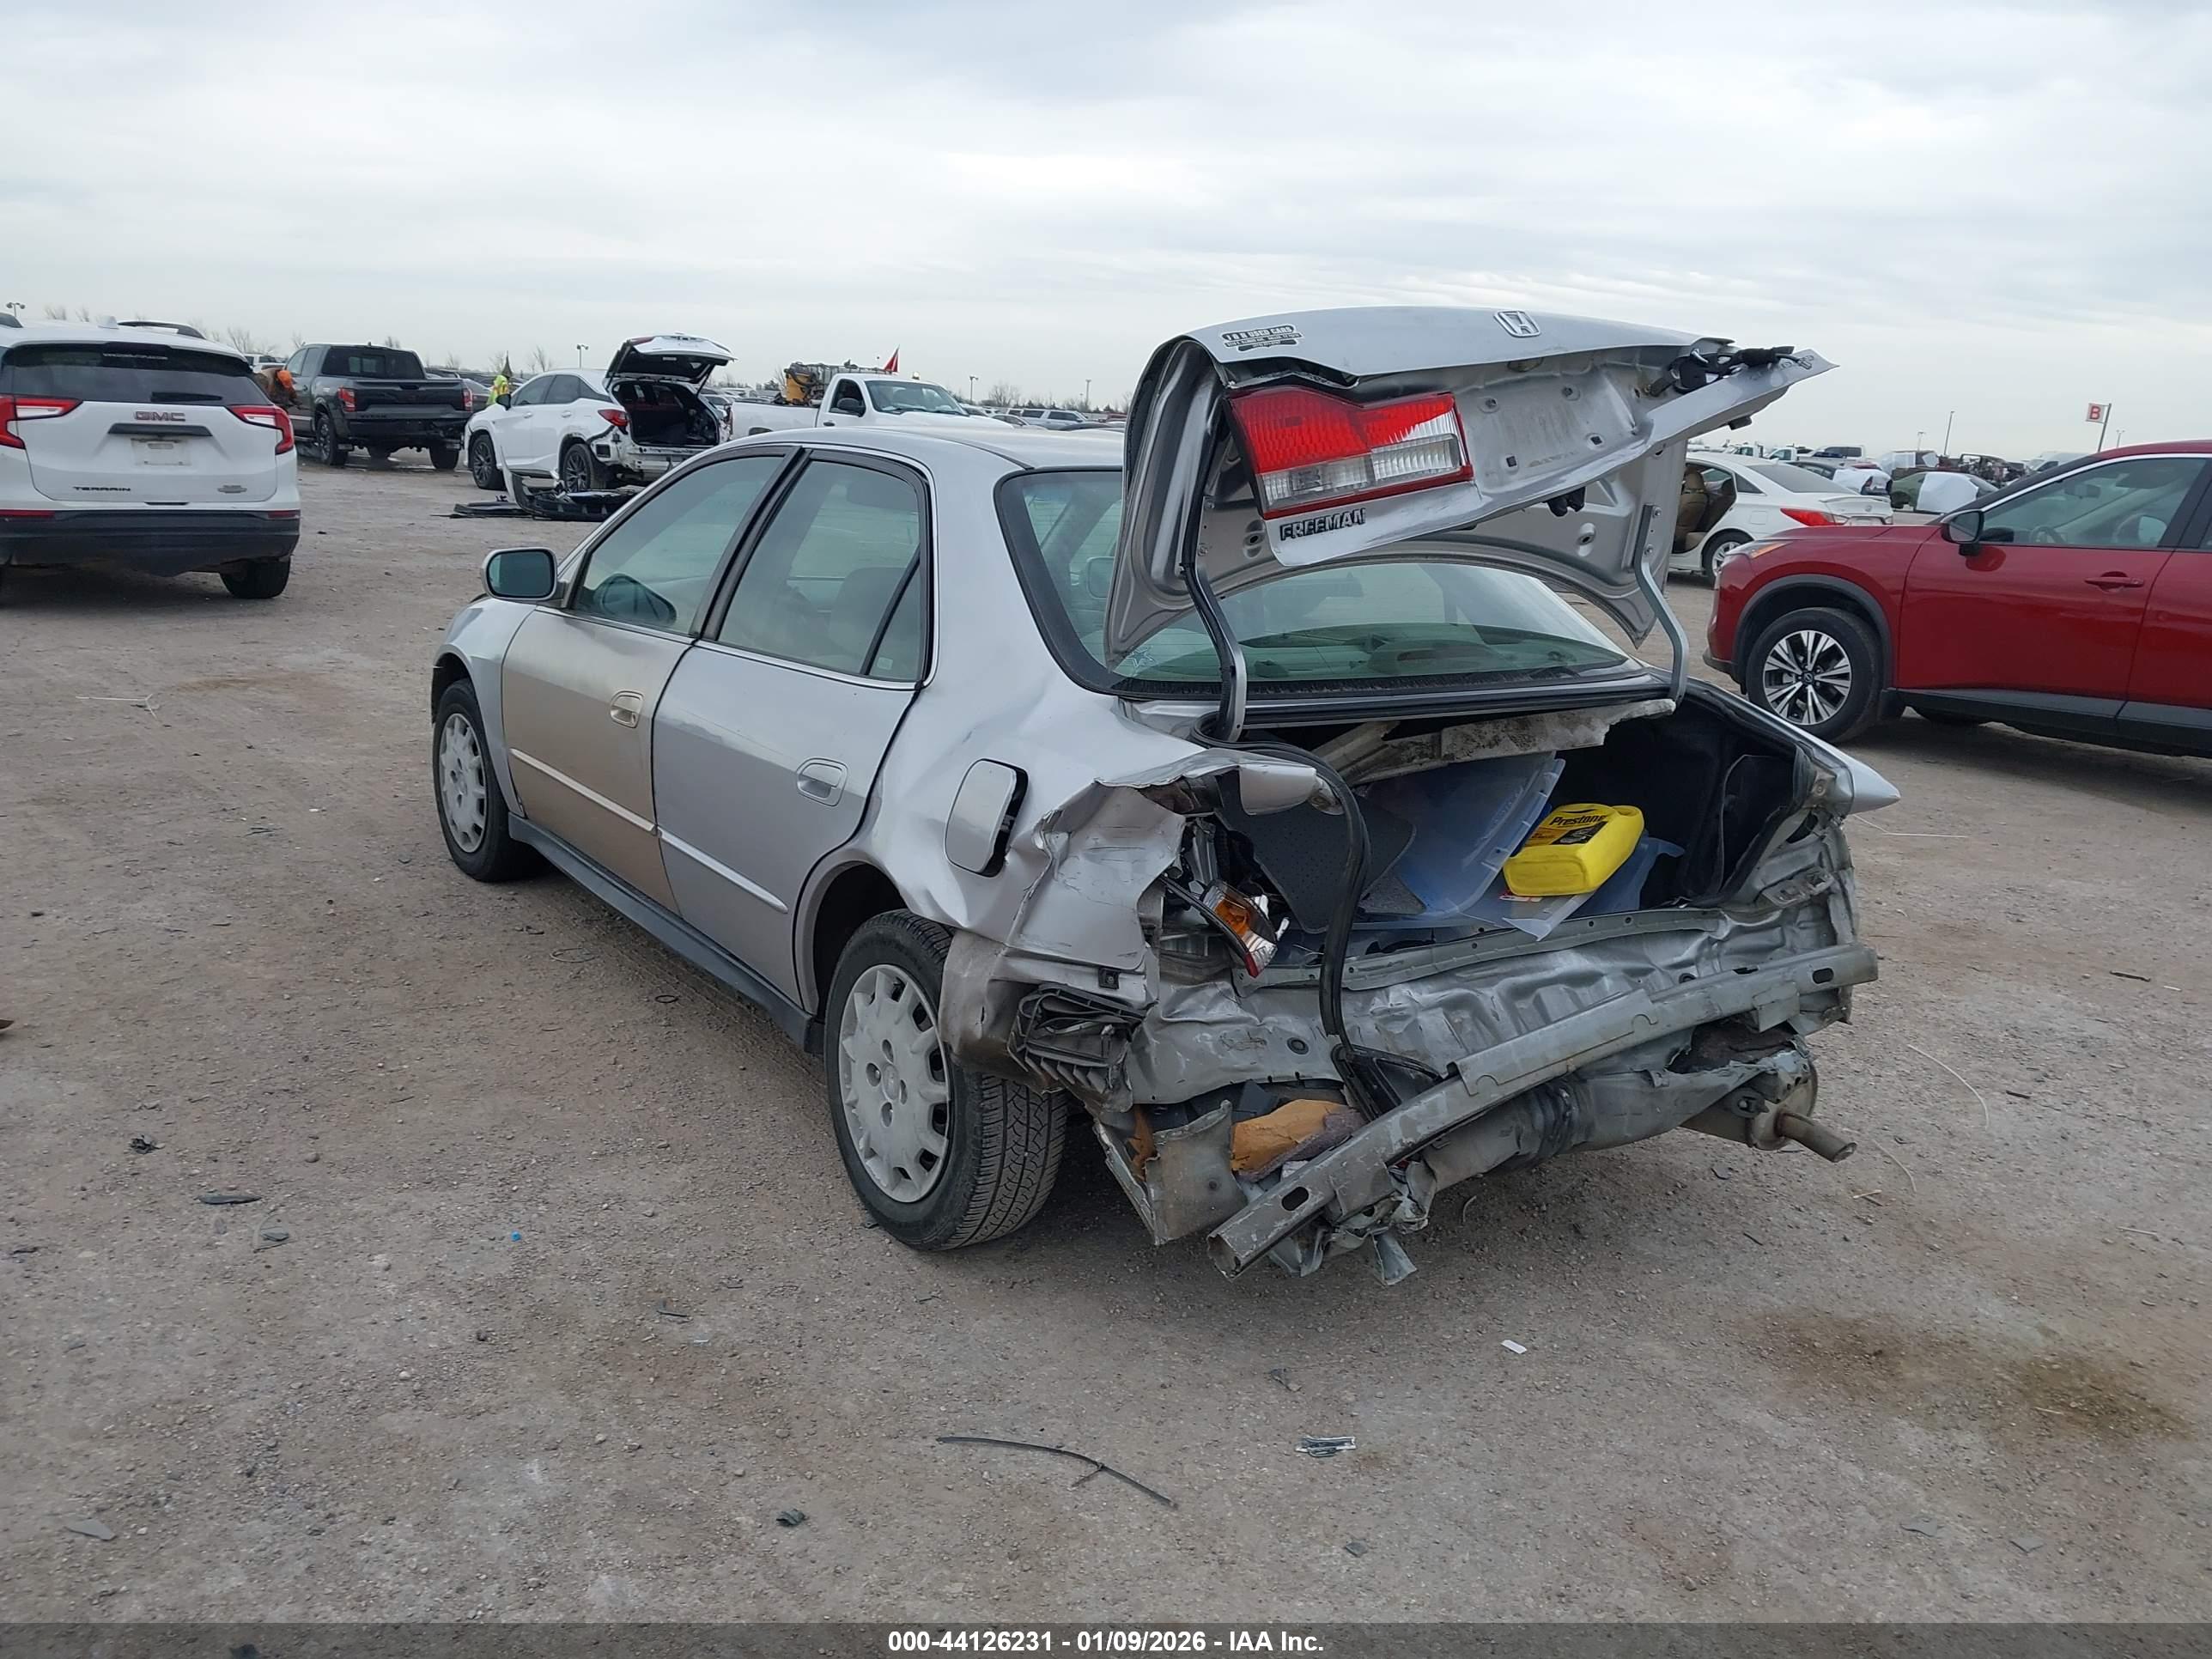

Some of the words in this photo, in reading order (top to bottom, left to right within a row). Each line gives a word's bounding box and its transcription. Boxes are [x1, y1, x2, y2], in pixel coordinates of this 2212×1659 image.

[1248, 329, 1270, 337] USED
[135, 410, 186, 422] GMC
[2090, 405, 2101, 420] B
[1279, 507, 1366, 541] FREEMAN
[1549, 814, 1608, 826] Prestone
